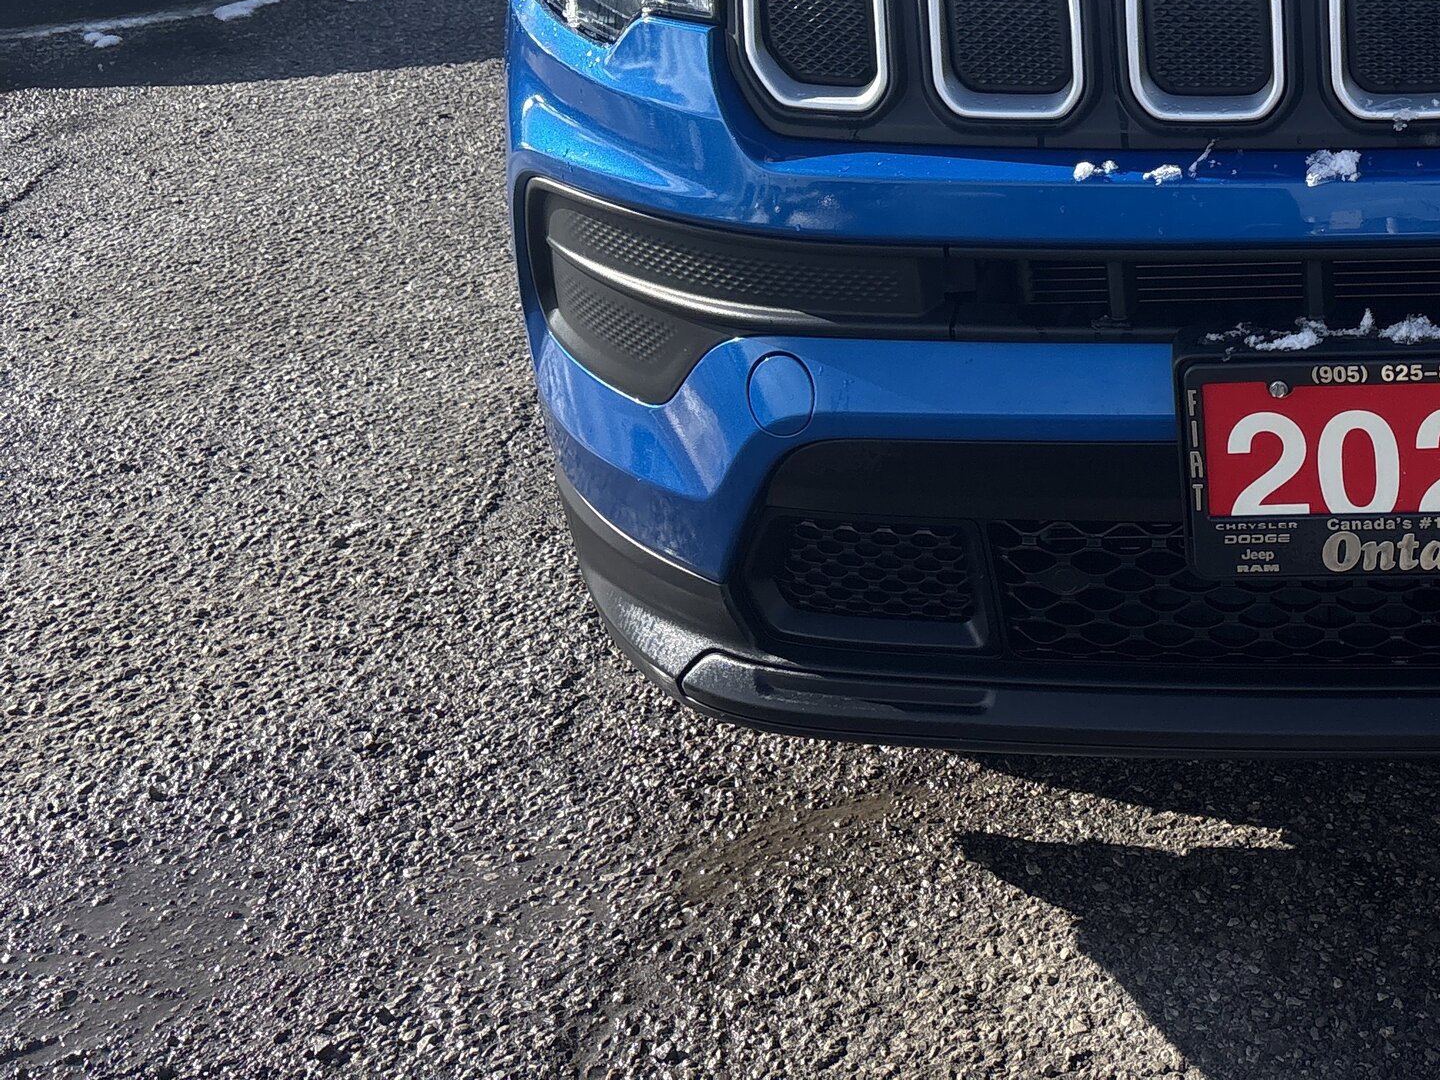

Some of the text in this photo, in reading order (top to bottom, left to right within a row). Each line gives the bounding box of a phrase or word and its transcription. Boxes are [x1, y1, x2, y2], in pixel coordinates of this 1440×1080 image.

[1311, 365, 1368, 384] (905)
[1187, 389, 1204, 511] FIAT
[1215, 522, 1298, 531] CHRYSLER
[1326, 518, 1412, 530] Canada's
[1224, 533, 1291, 545] DODGE
[1241, 549, 1275, 562] Jeep
[1237, 564, 1280, 573] RAM
